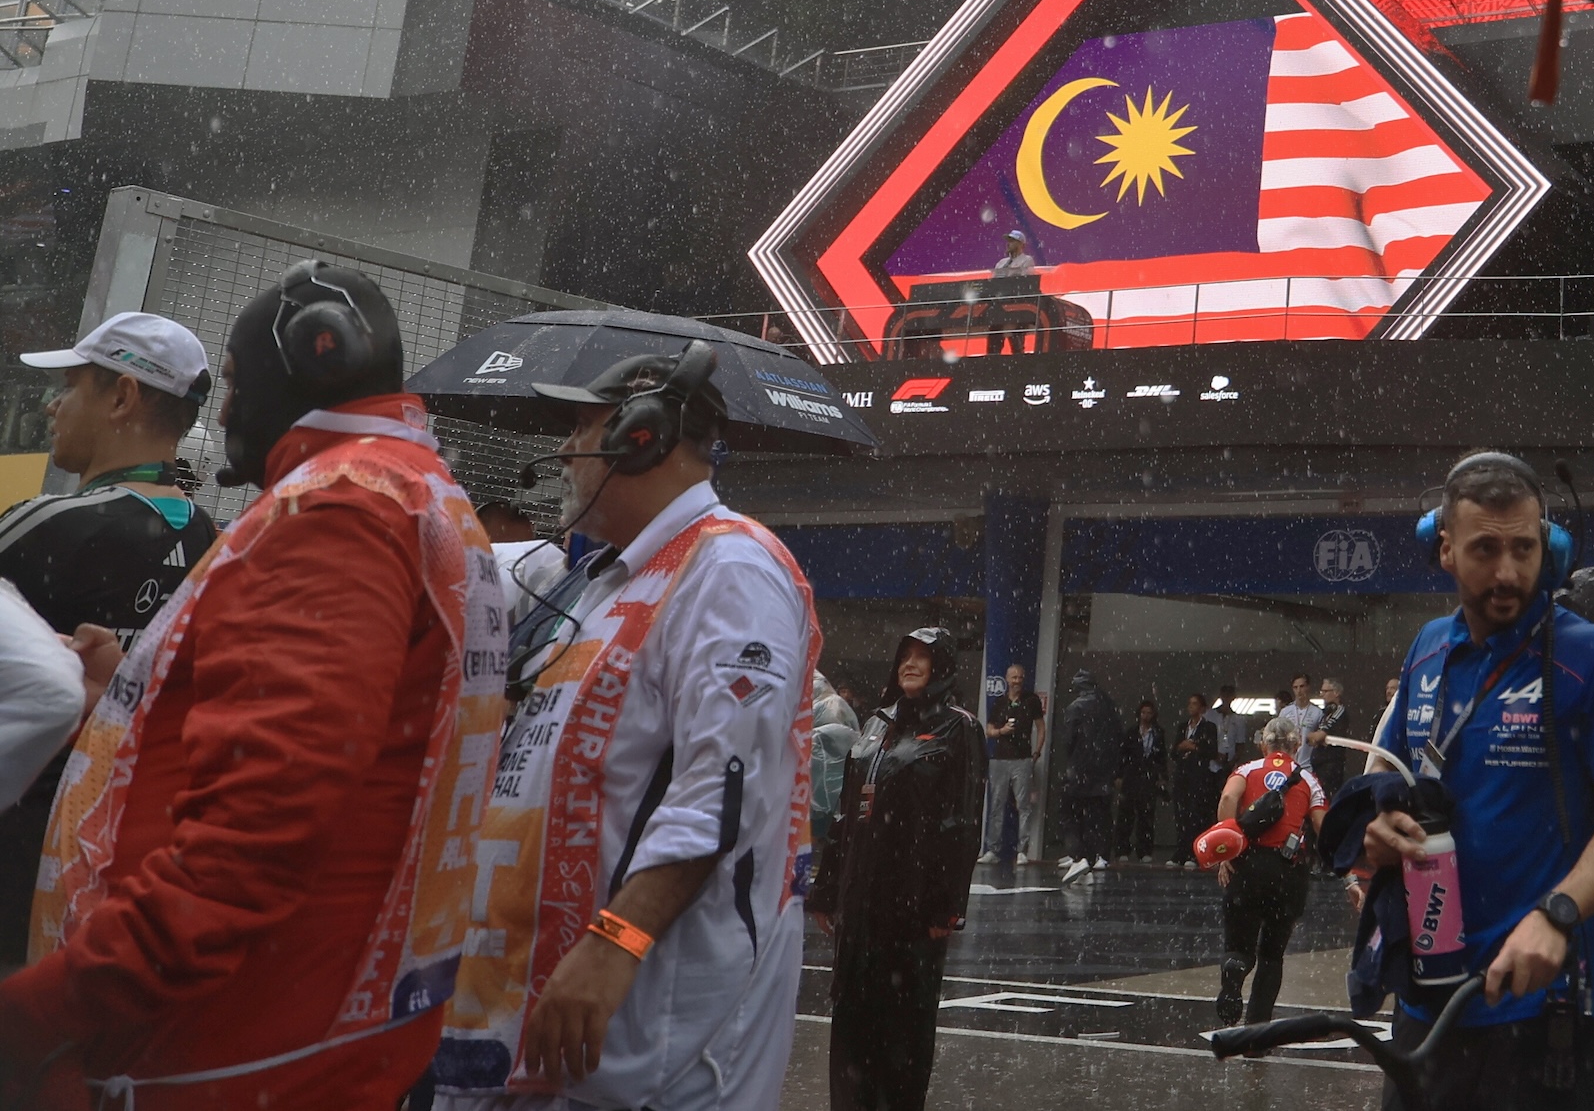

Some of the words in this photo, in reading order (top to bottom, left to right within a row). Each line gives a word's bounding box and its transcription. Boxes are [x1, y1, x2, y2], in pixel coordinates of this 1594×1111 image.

[764, 370, 828, 394] ATLASSIAN
[968, 390, 1005, 402] PIRELLI
[1024, 384, 1050, 397] aws
[1071, 389, 1106, 400] Heineken
[1133, 385, 1171, 397] DHL
[1200, 390, 1238, 402] salesforce
[764, 388, 844, 419] Williams
[841, 391, 874, 408] MH
[1512, 712, 1539, 724] BWT
[565, 645, 631, 847] BAHRAIN
[1267, 773, 1284, 790] hp
[1422, 882, 1447, 933] BWT
